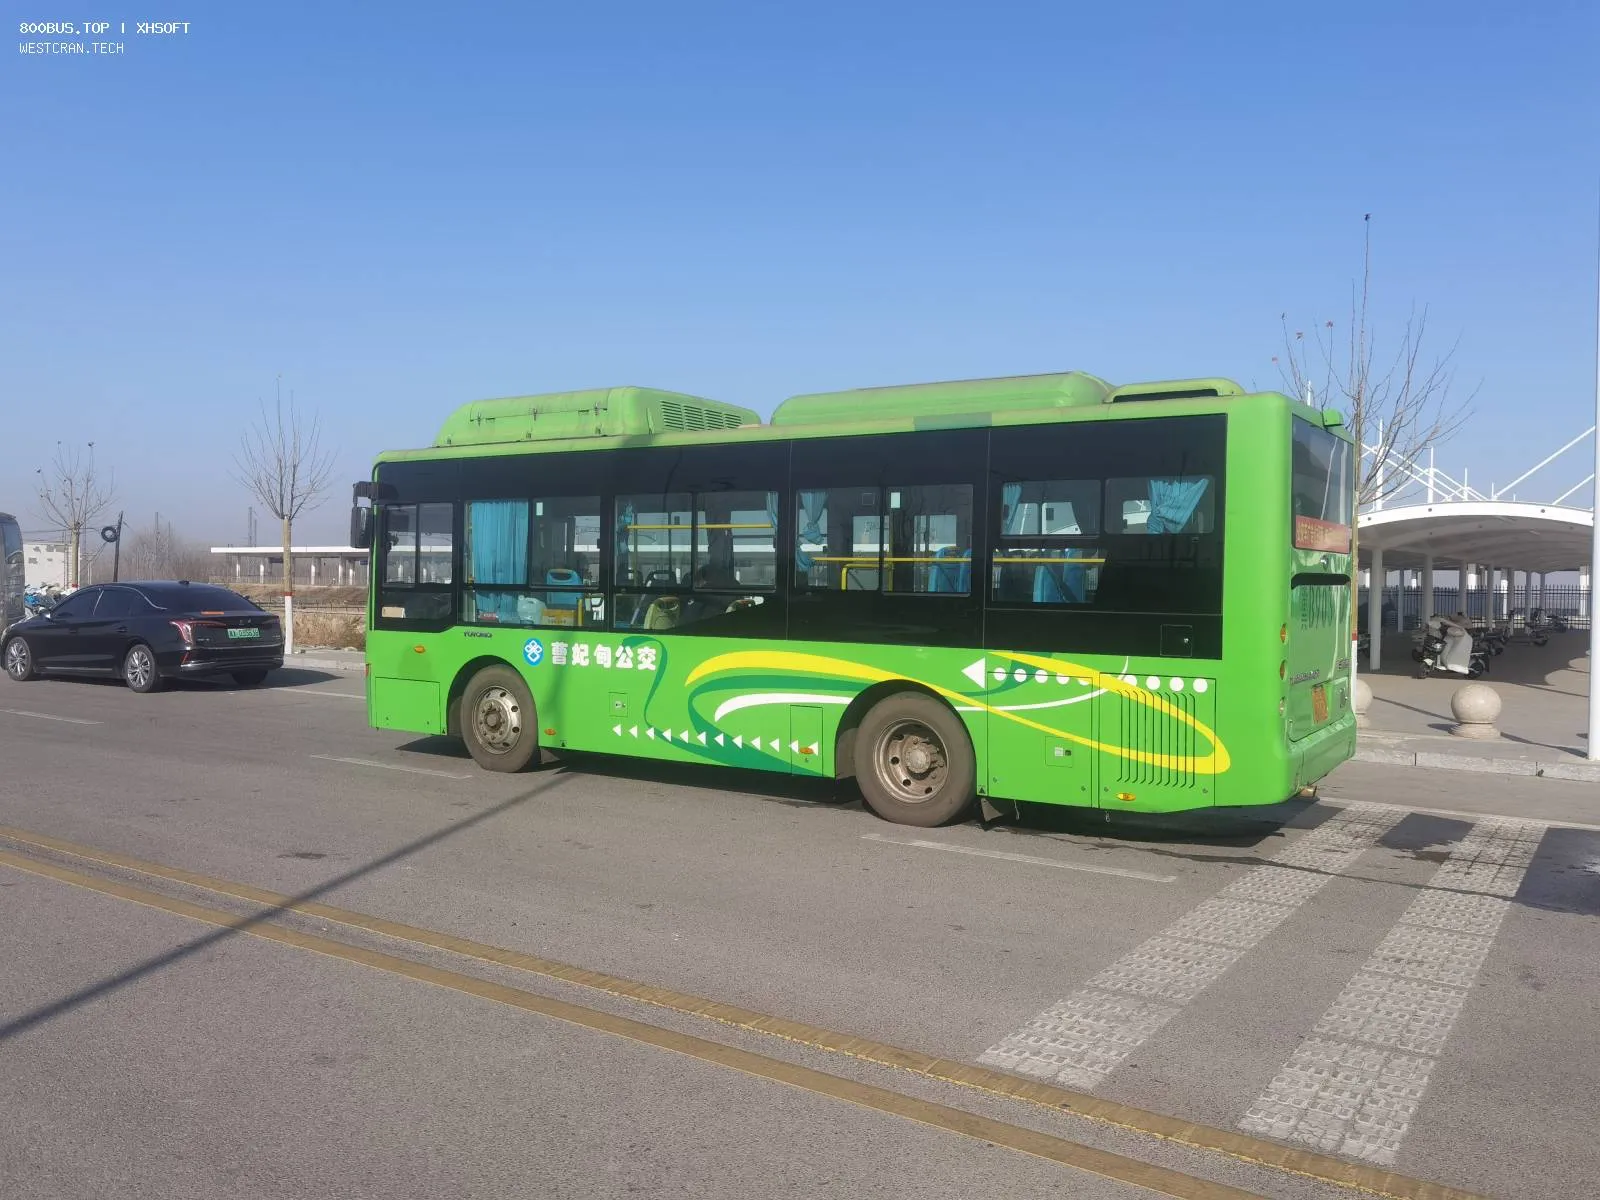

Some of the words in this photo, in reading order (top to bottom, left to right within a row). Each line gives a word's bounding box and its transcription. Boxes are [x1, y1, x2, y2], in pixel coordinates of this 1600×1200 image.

[551, 641, 657, 671] 曹妃甸公交
